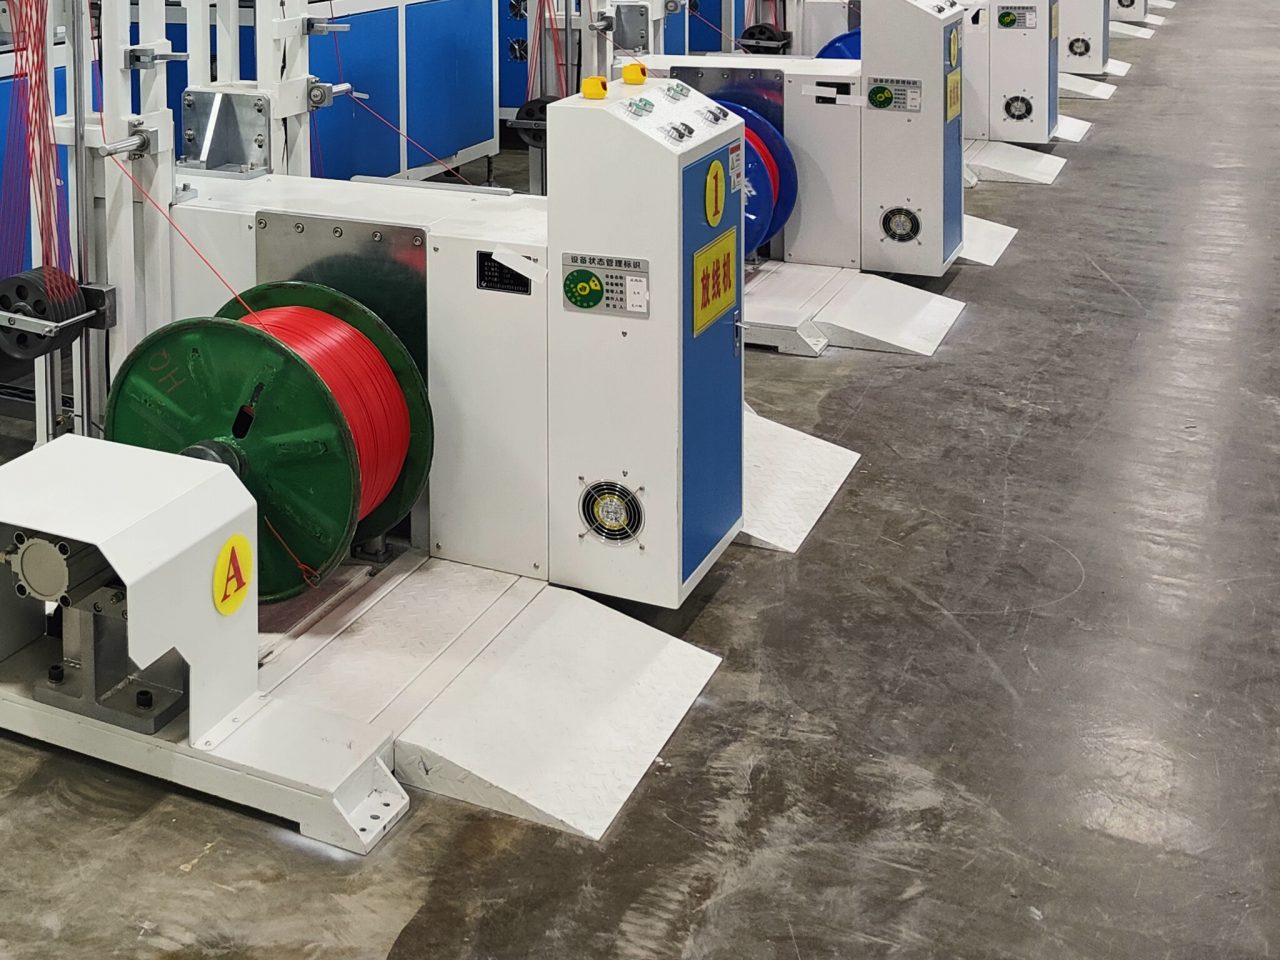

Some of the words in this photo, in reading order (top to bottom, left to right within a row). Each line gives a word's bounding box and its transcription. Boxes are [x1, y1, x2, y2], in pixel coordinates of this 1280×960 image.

[712, 170, 721, 218] 1
[570, 255, 641, 269] 设备状态管理标识
[700, 251, 732, 310] 放线机
[221, 545, 247, 603] A
